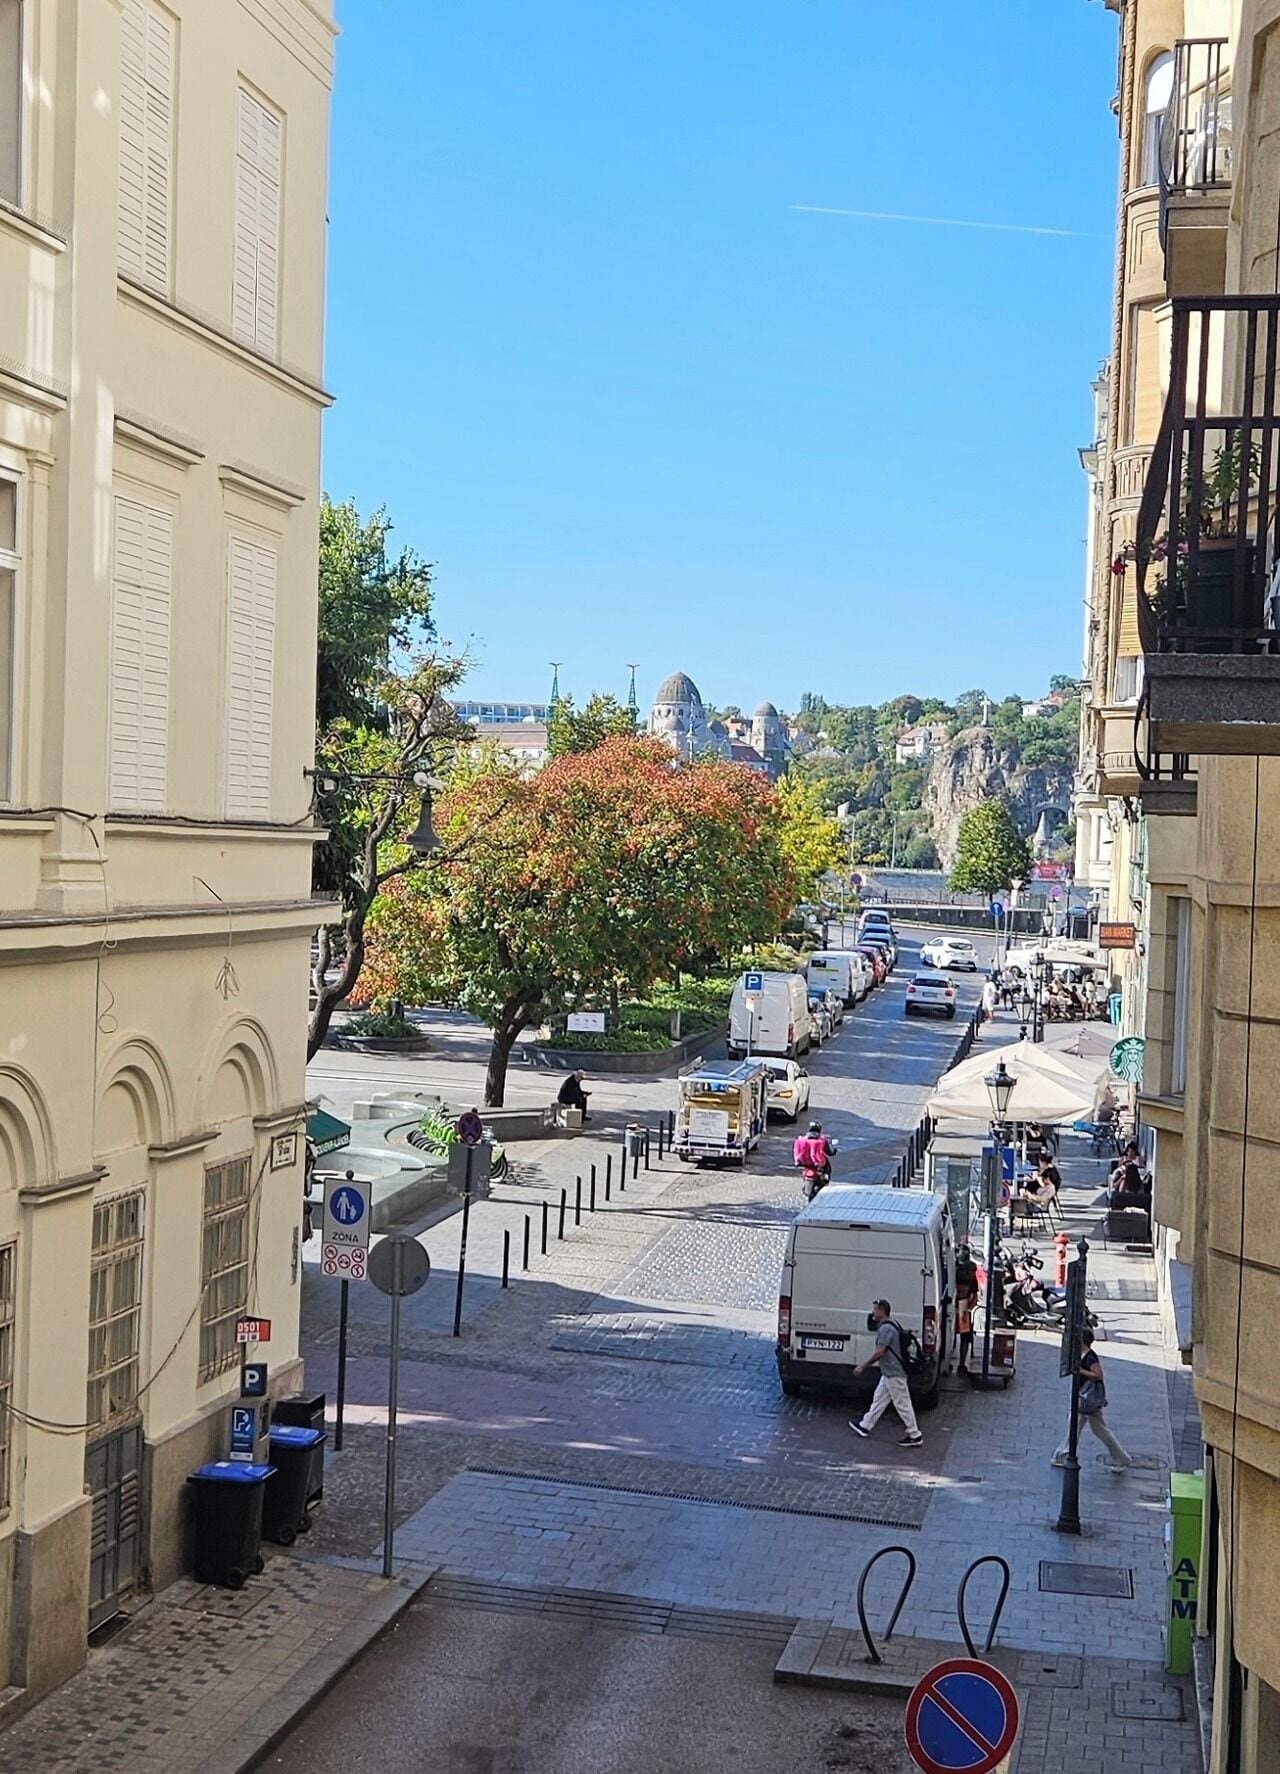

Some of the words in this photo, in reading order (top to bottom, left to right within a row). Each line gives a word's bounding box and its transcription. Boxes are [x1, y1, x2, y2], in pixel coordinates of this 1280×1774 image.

[748, 976, 759, 988] P
[332, 1232, 359, 1243] ZONA
[237, 1321, 260, 1332] 0501
[245, 1370, 260, 1389] P
[1172, 1557, 1197, 1620] ATM
